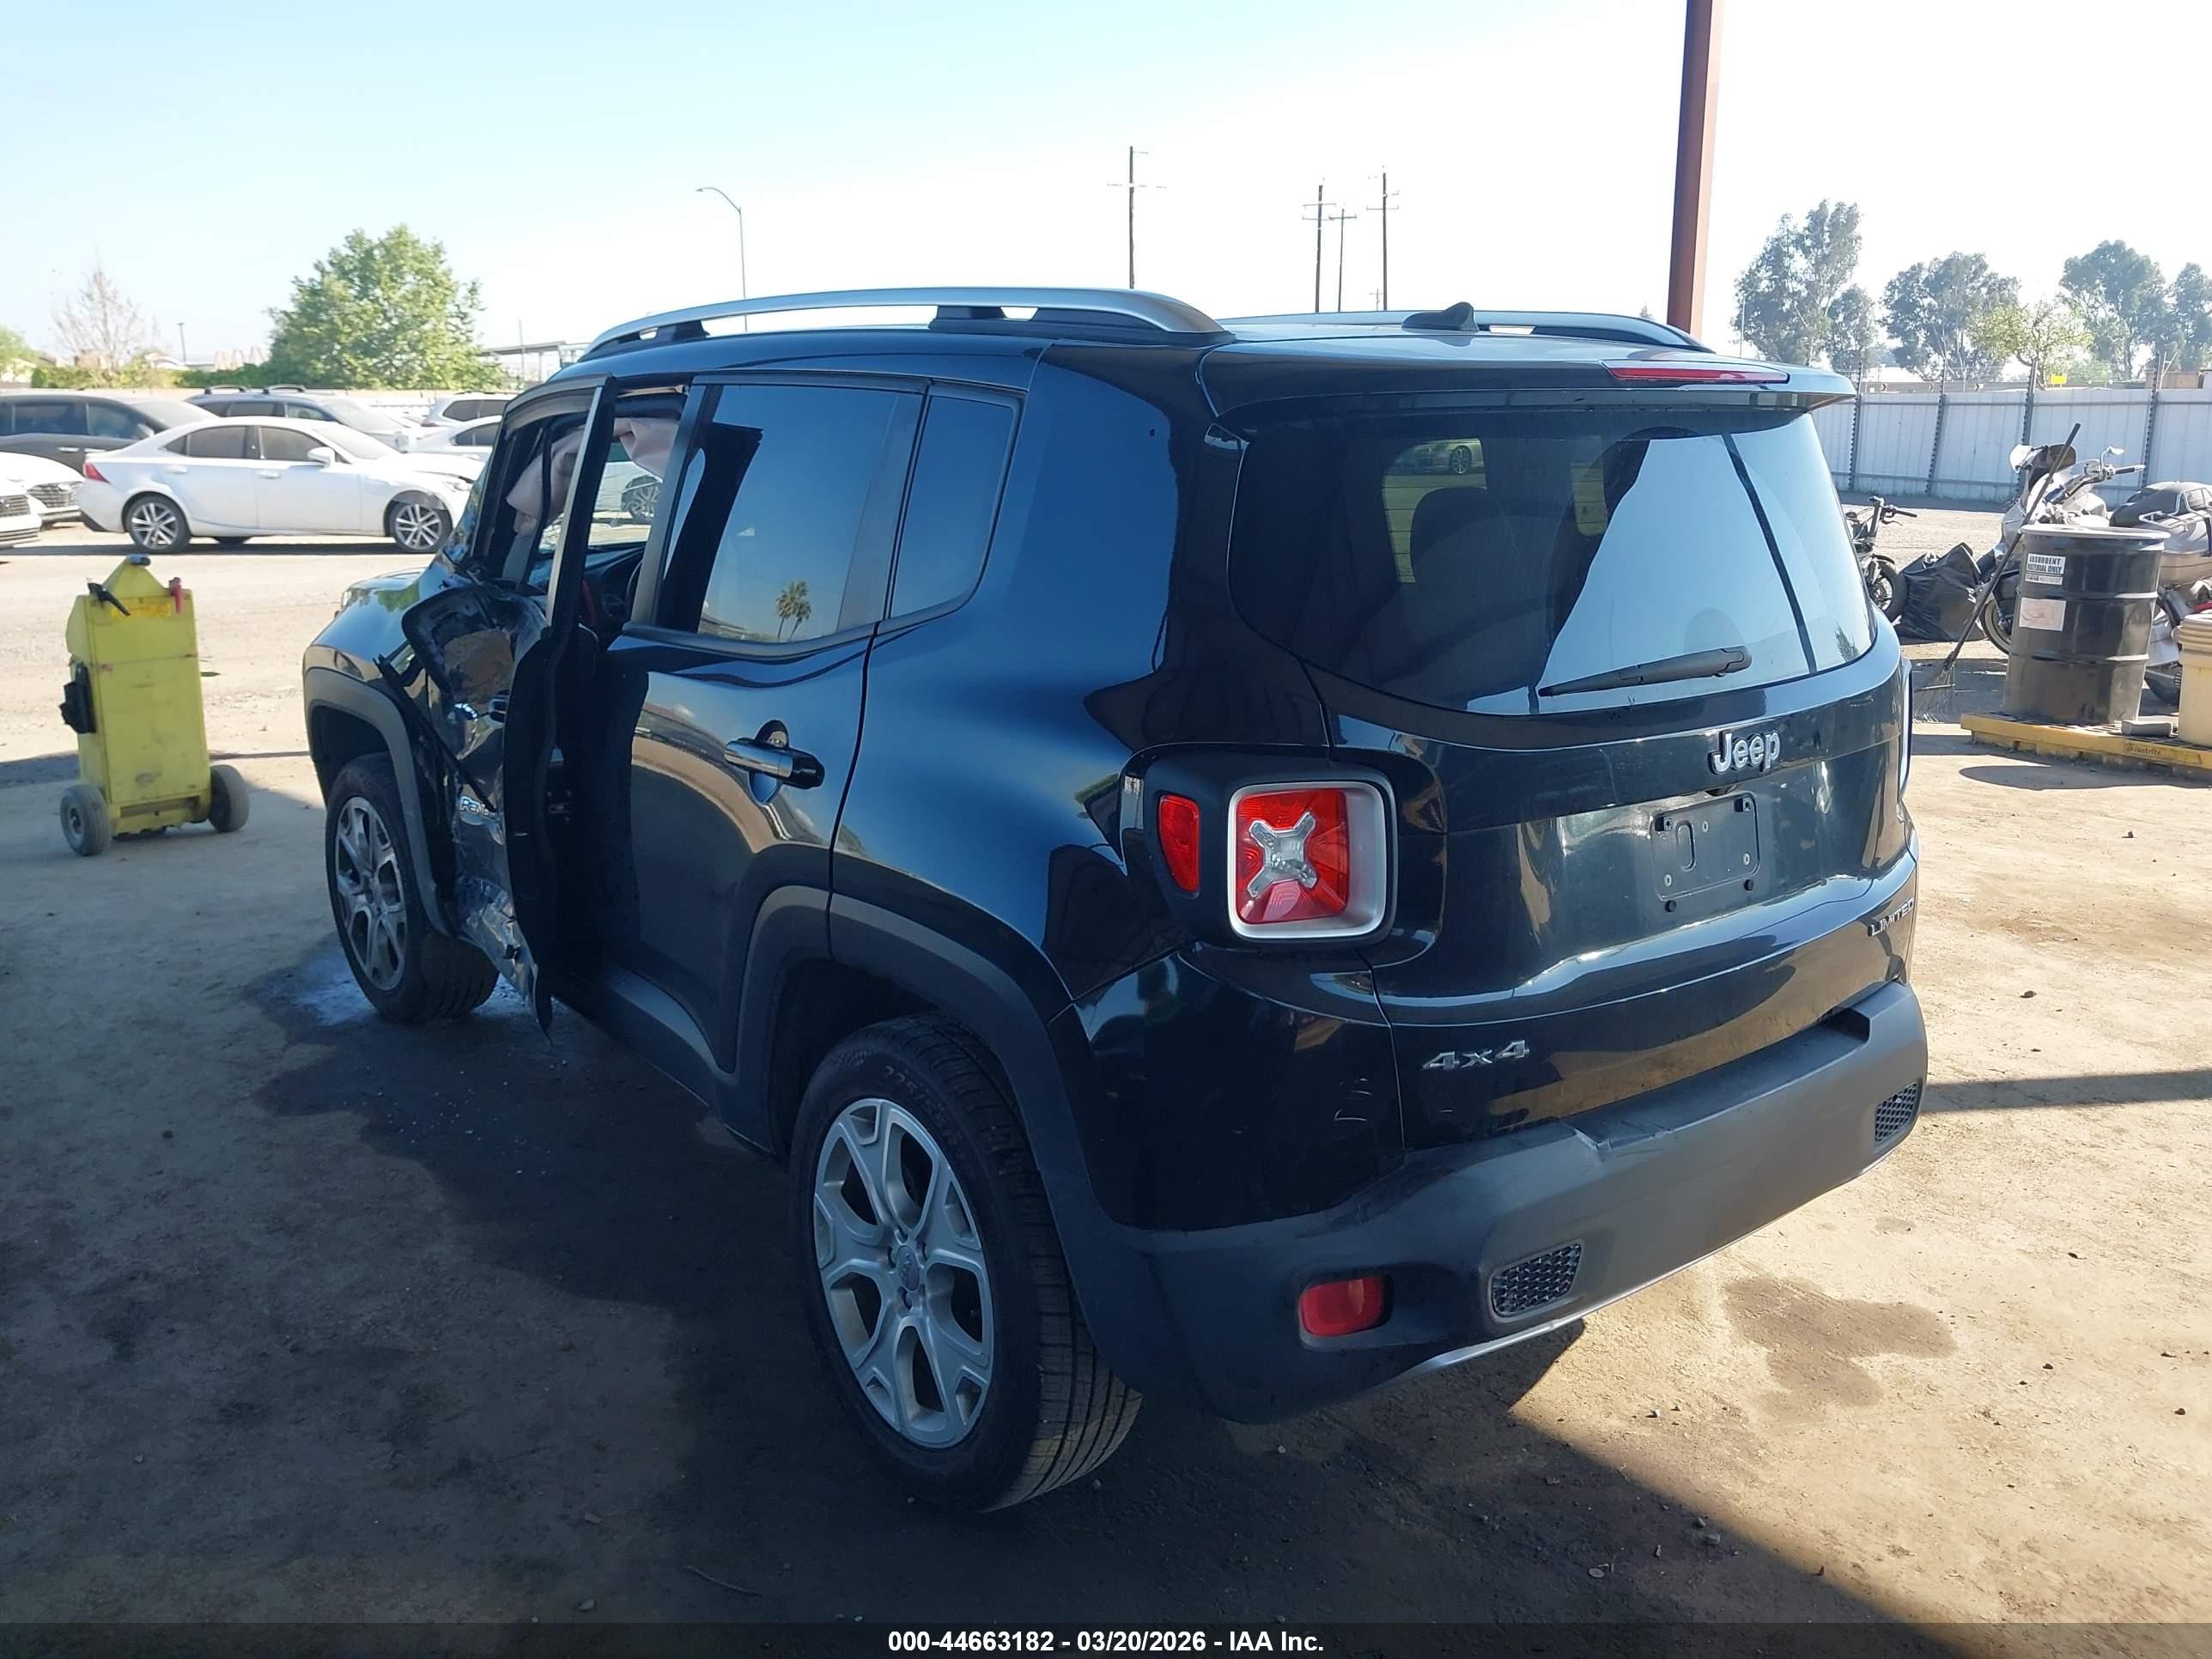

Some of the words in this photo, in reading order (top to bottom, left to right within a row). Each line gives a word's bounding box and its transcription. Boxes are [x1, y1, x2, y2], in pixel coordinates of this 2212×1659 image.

[2047, 565, 2063, 574] ONLY
[1709, 730, 1780, 774] Jeep
[1870, 898, 1914, 936] LIMITED
